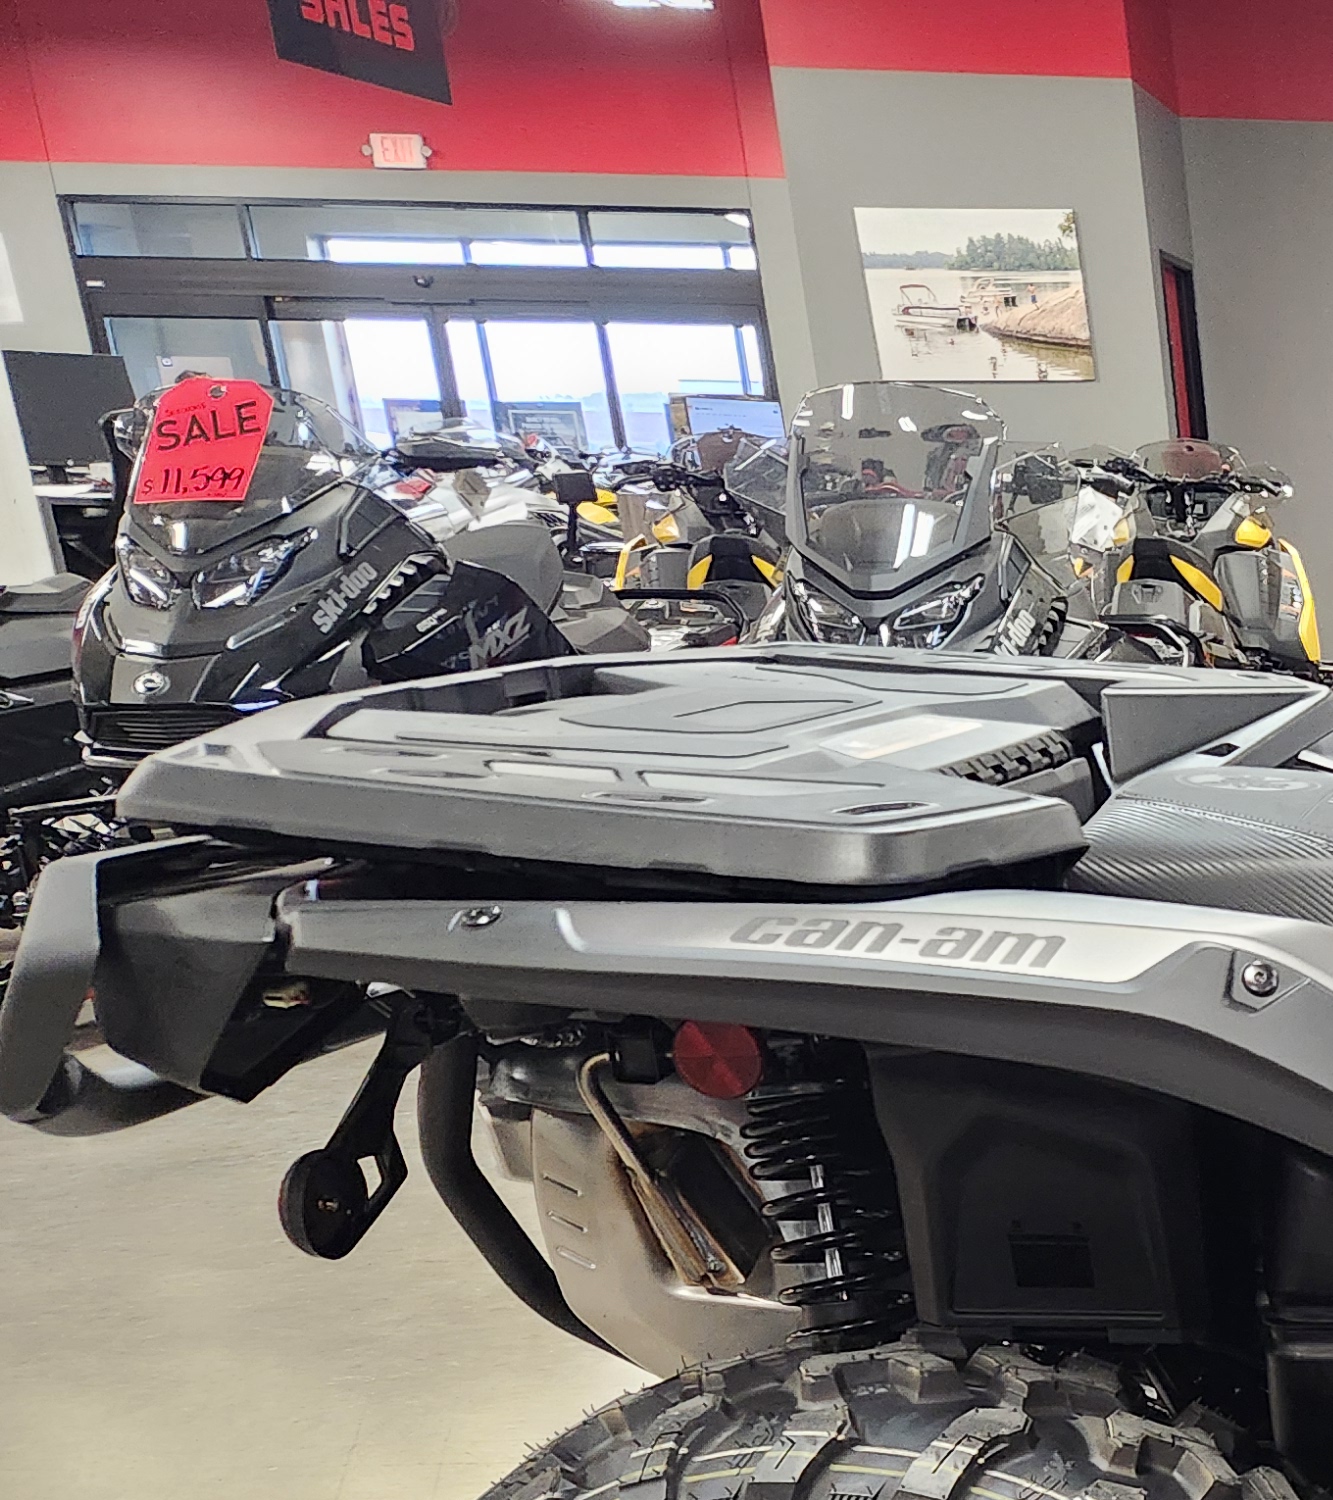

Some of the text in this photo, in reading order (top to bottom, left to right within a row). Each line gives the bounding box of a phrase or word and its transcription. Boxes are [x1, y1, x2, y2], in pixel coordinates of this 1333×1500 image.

[380, 136, 415, 163] EXIT
[155, 401, 261, 450] SALE
[312, 562, 378, 634] ski-doo
[729, 917, 1066, 968] can-am
